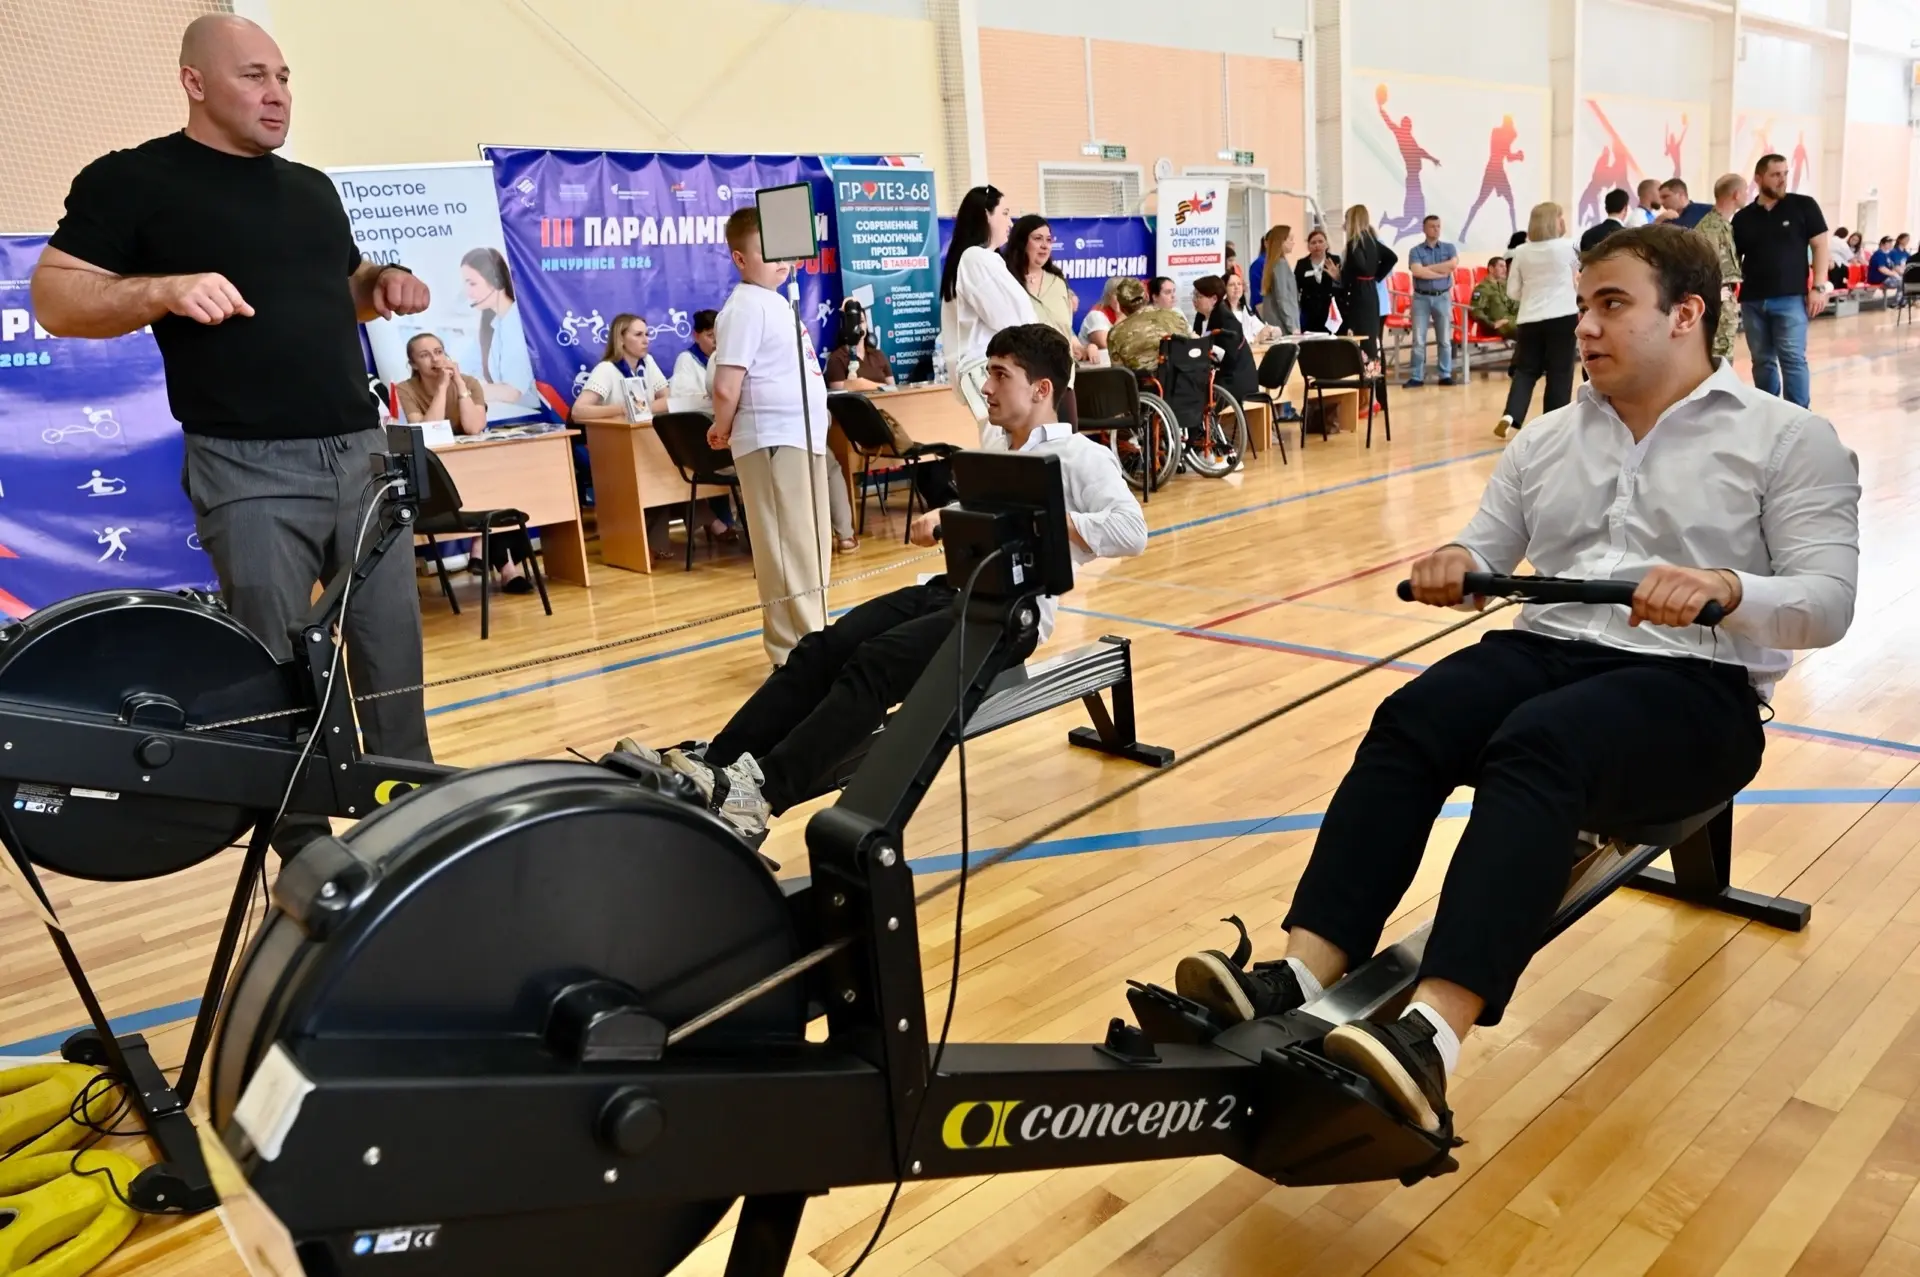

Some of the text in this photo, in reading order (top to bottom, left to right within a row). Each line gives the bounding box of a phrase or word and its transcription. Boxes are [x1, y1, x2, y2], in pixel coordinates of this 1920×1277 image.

[341, 181, 426, 202] Простое
[349, 201, 468, 225] решение по
[541, 217, 574, 248] III
[855, 220, 919, 231] СОВРЕМЕННЫЕ
[1169, 226, 1220, 237] ЗАЩИТНИКИ
[354, 224, 453, 245] вопросам
[852, 233, 924, 244] ТЕХНОЛОГИЧНЫЕ
[1172, 237, 1216, 248] ОТЕЧЕСТВА
[871, 246, 908, 257] ПРОТЕЗЫ
[541, 255, 653, 272] МИЧУРИНСК 2026
[851, 258, 928, 271] ТЕПЕРЬ В ТАМБОВЕ
[0, 351, 51, 368] 2026
[1020, 1094, 1237, 1140] concept 2
